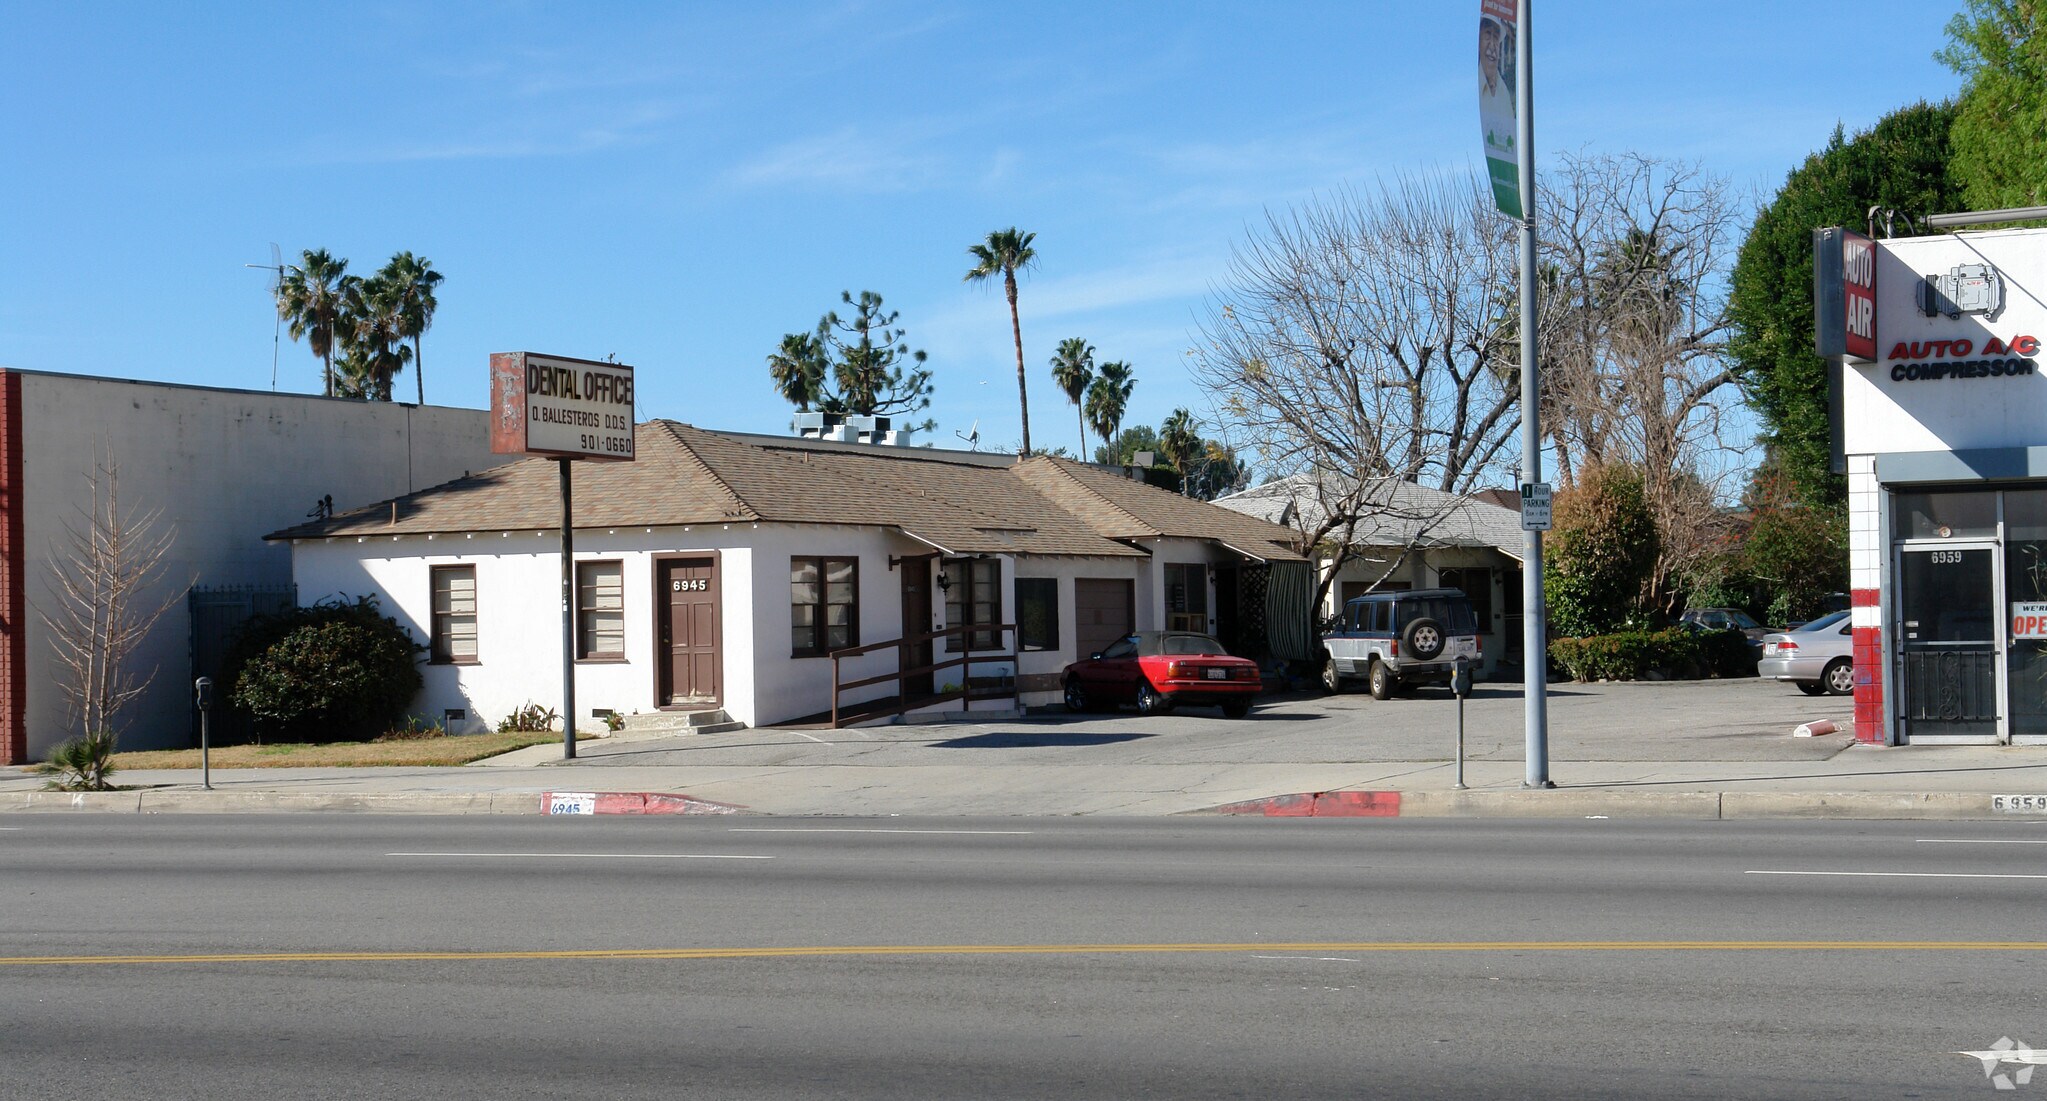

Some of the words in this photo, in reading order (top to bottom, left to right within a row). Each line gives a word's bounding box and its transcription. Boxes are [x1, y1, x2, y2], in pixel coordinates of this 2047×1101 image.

[1845, 241, 1873, 289] AUTO
[1847, 293, 1873, 339] AIR
[1888, 338, 1973, 360] AUTO
[1982, 334, 2038, 356] A/C
[1890, 358, 2033, 382] COMPRESSOR
[528, 363, 581, 400] DENTAL
[583, 371, 632, 406] OFFICE
[542, 406, 600, 428] BALLESTEROS
[605, 415, 627, 431] D.D.S.
[581, 434, 632, 453] 901-0660
[1534, 487, 1549, 496] HOUR
[1523, 499, 1550, 508] PARKING
[1931, 551, 1962, 564] 6959
[673, 580, 706, 591] 6945
[551, 803, 580, 814] 6945
[1994, 797, 2047, 810] 6959
